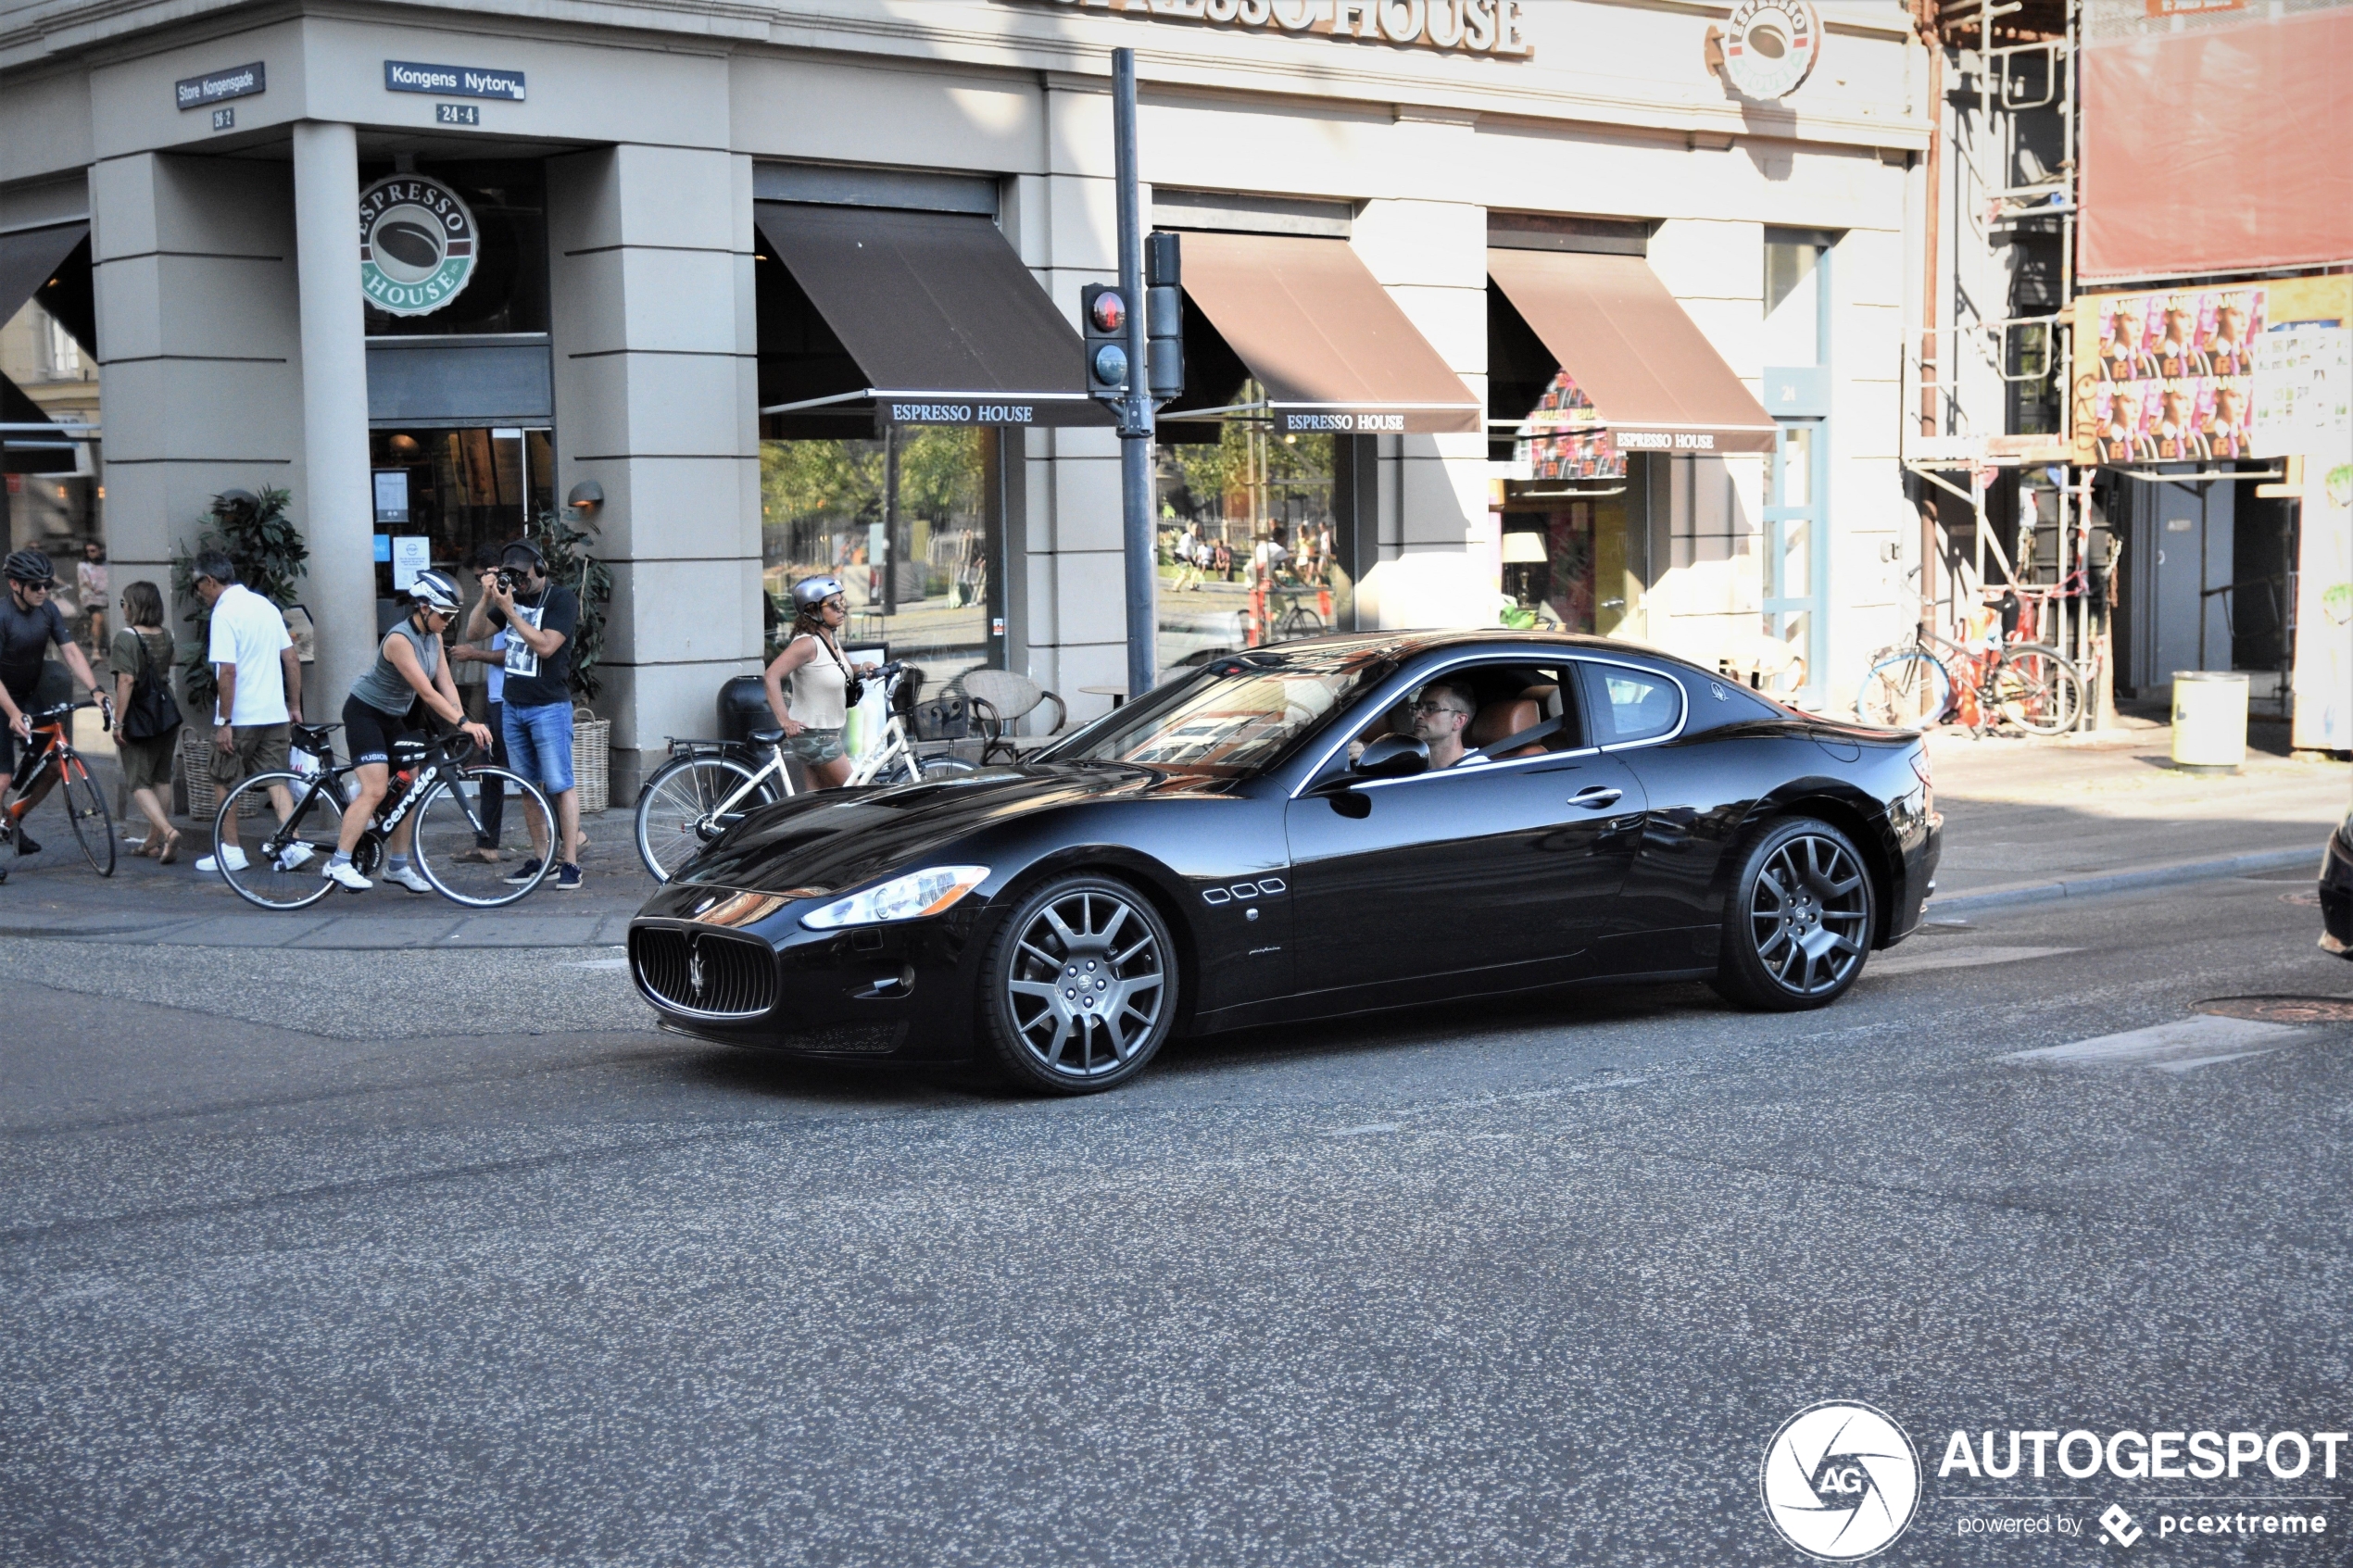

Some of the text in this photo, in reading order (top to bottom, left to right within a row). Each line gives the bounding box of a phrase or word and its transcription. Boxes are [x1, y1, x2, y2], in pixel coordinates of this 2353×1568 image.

[1331, 0, 1527, 53] HOUSE
[179, 70, 254, 102] Store Kongensgade
[393, 66, 516, 93] Kongens Nytorv
[359, 182, 464, 237] ESPRESSO
[366, 271, 456, 306] HOUSE
[2100, 295, 2147, 316] DANS
[2151, 293, 2198, 313] DANS
[892, 404, 1033, 422] ESPRESSO HOUSE
[1287, 414, 1404, 431] ESPRESSO HOUSE
[1617, 433, 1714, 449] ESPRESSO HOUSE
[360, 753, 389, 762] FUSION
[382, 766, 437, 833] cervélo
